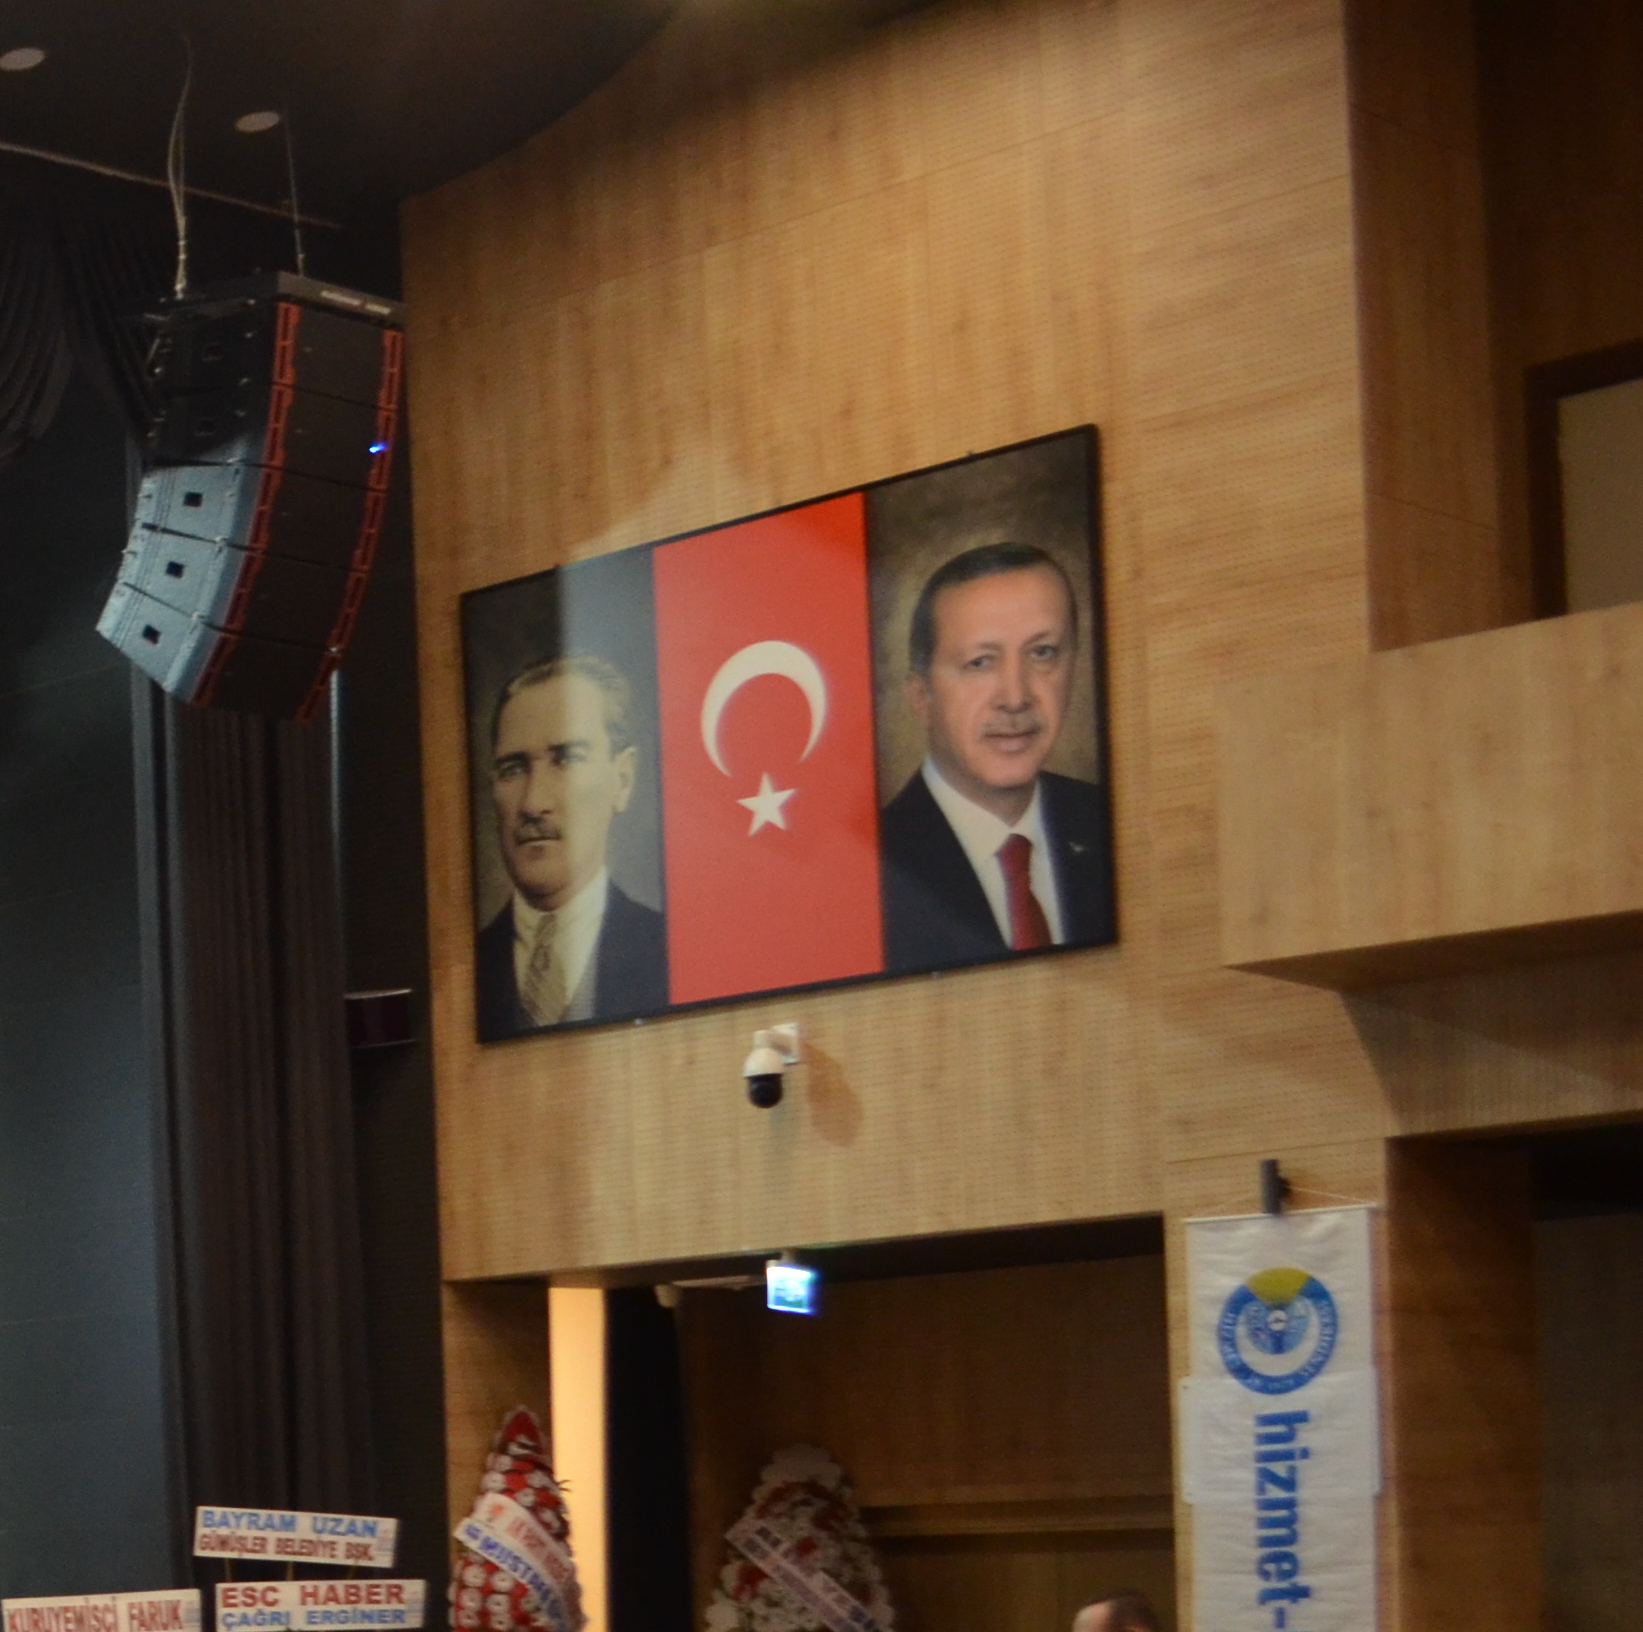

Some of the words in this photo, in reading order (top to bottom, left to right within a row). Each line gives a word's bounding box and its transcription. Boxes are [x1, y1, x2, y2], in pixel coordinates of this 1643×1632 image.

[202, 1510, 297, 1532] BAYRAM
[312, 1516, 379, 1538] UZAN
[221, 1586, 279, 1608] ESC
[300, 1583, 407, 1606] HABER
